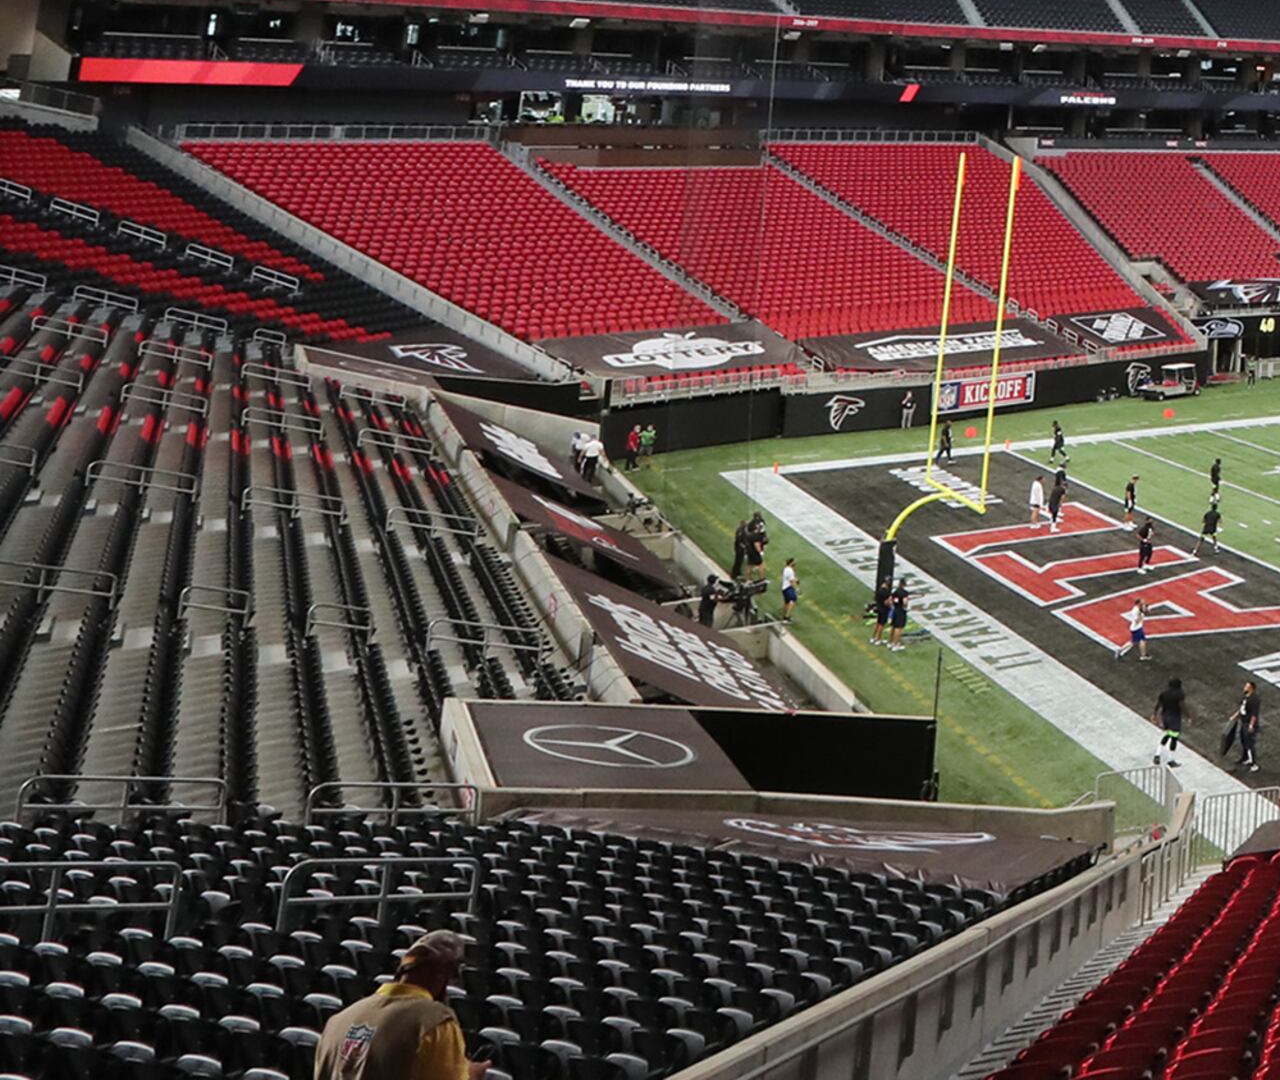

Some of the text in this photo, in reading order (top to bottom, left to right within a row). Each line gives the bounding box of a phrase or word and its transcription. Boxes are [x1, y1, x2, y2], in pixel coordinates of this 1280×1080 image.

[565, 79, 595, 88] THANK
[597, 80, 614, 89] YOU
[616, 80, 627, 89] TO
[1259, 318, 1276, 333] 40
[613, 340, 763, 365] LOTTERY
[964, 378, 1023, 404] KICOFF
[909, 599, 1009, 650] TAKES
